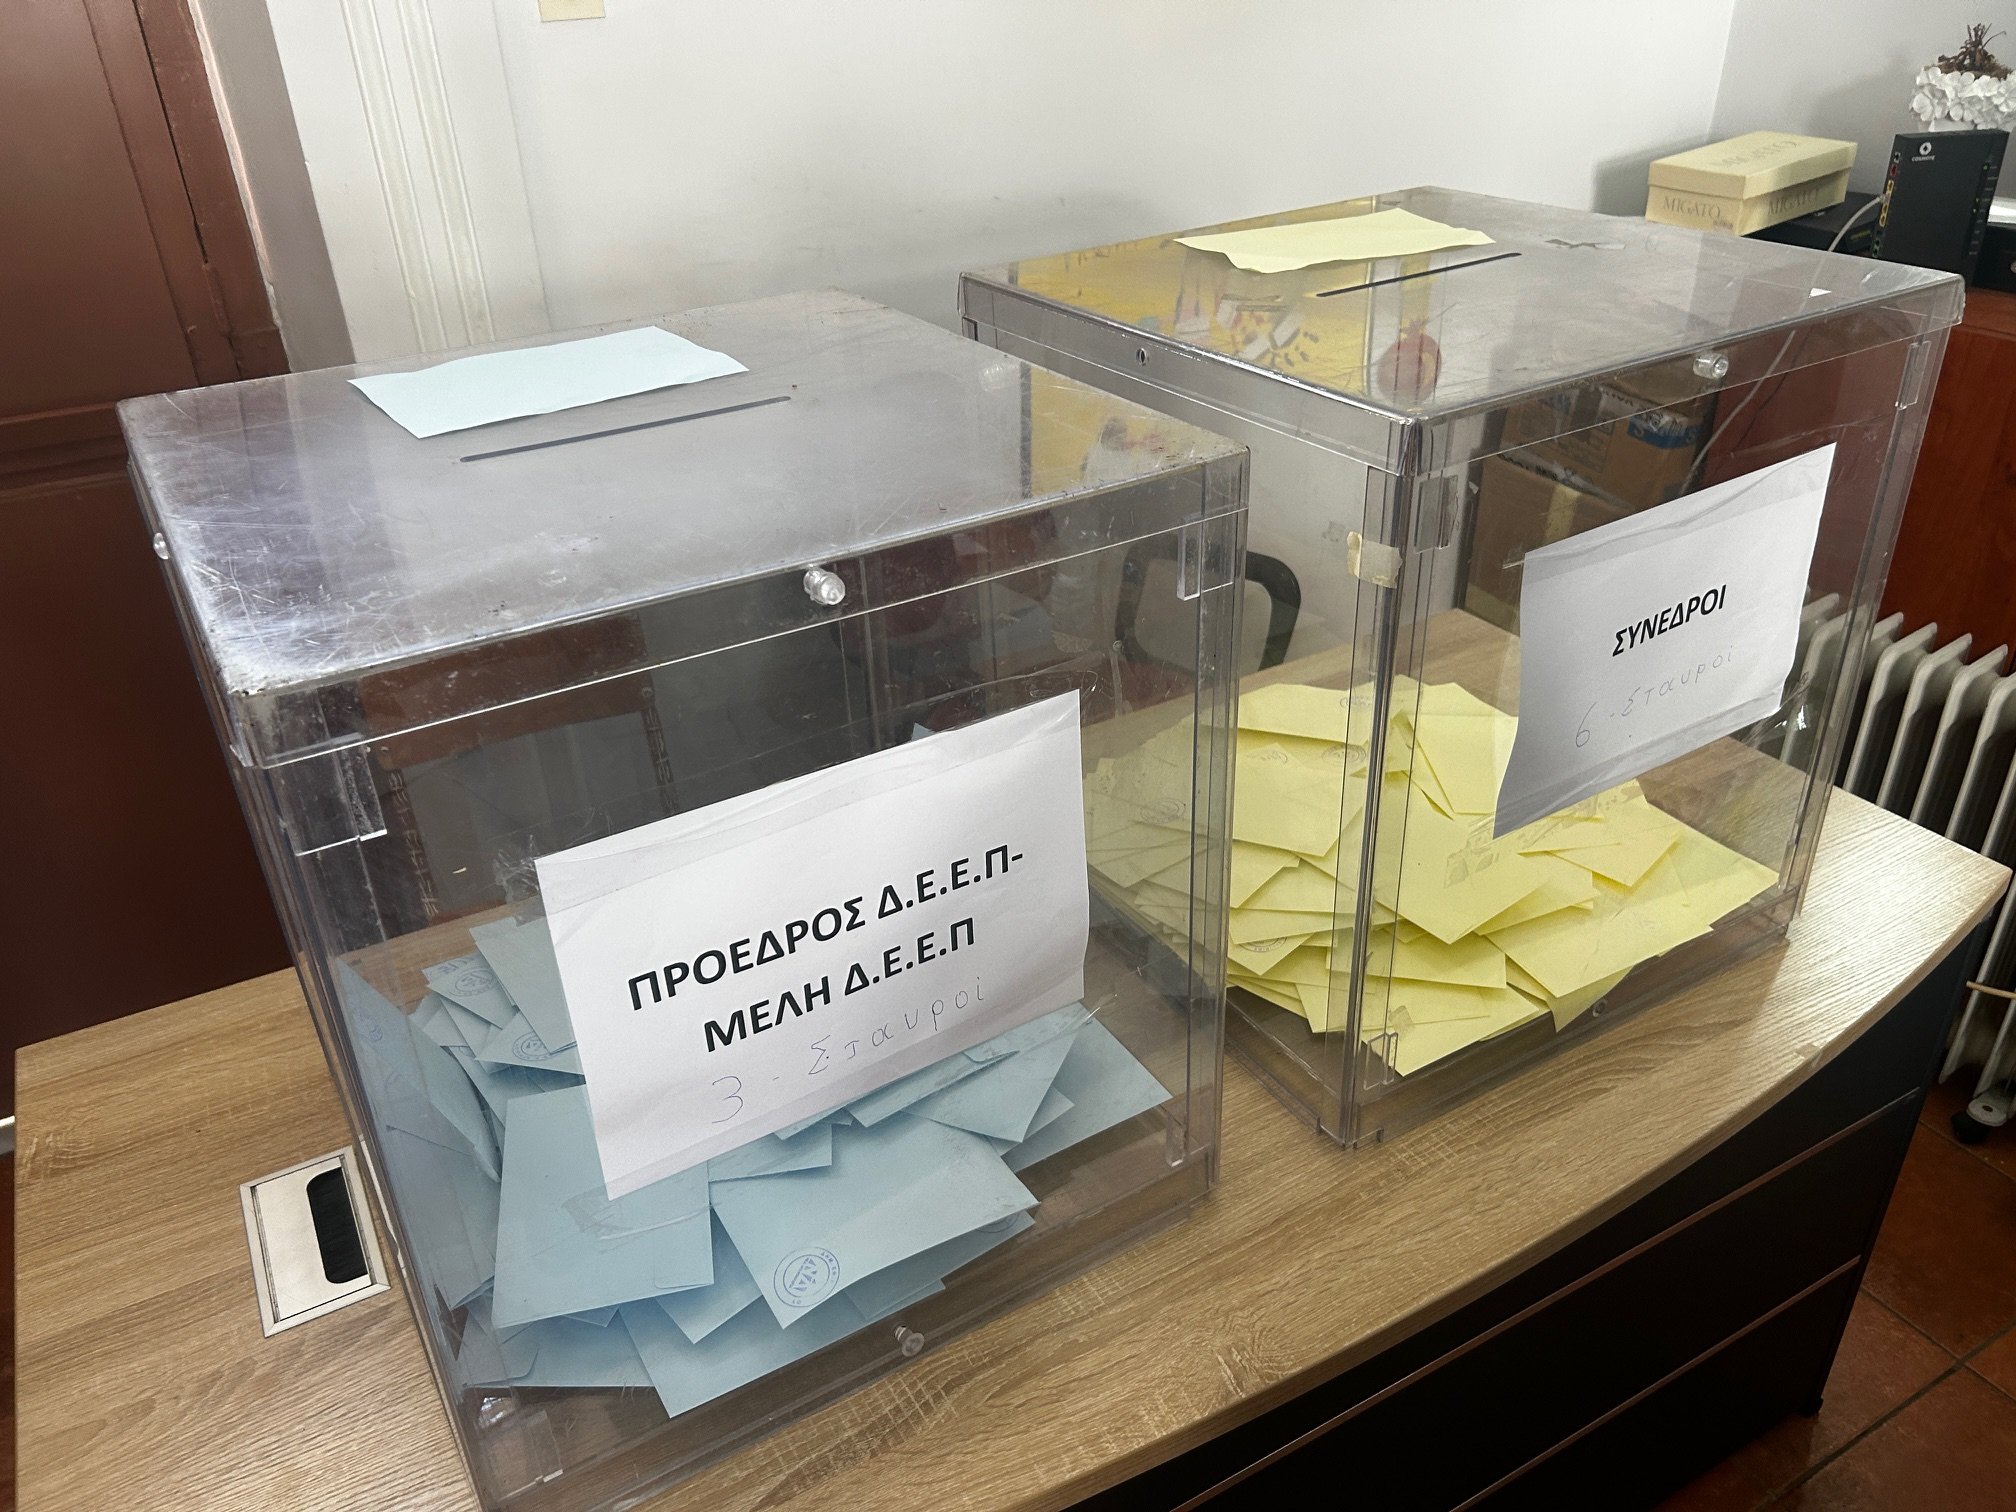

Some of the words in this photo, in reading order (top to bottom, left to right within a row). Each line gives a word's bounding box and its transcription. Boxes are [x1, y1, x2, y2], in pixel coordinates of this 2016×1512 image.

[1662, 196, 1721, 218] MIGATO
[1612, 584, 1726, 657] ΣΥΝΕΔΡΟΙ
[1575, 701, 1597, 748] 6
[628, 896, 866, 1010] ΠΡΟΕΔΡΟΣ
[877, 845, 1024, 919] Δ.Ε.Ε.Π-
[703, 976, 831, 1053] ΜΕΛΗ
[844, 918, 975, 996] Δ.Ε.Ε.Π
[711, 1075, 744, 1124] 3
